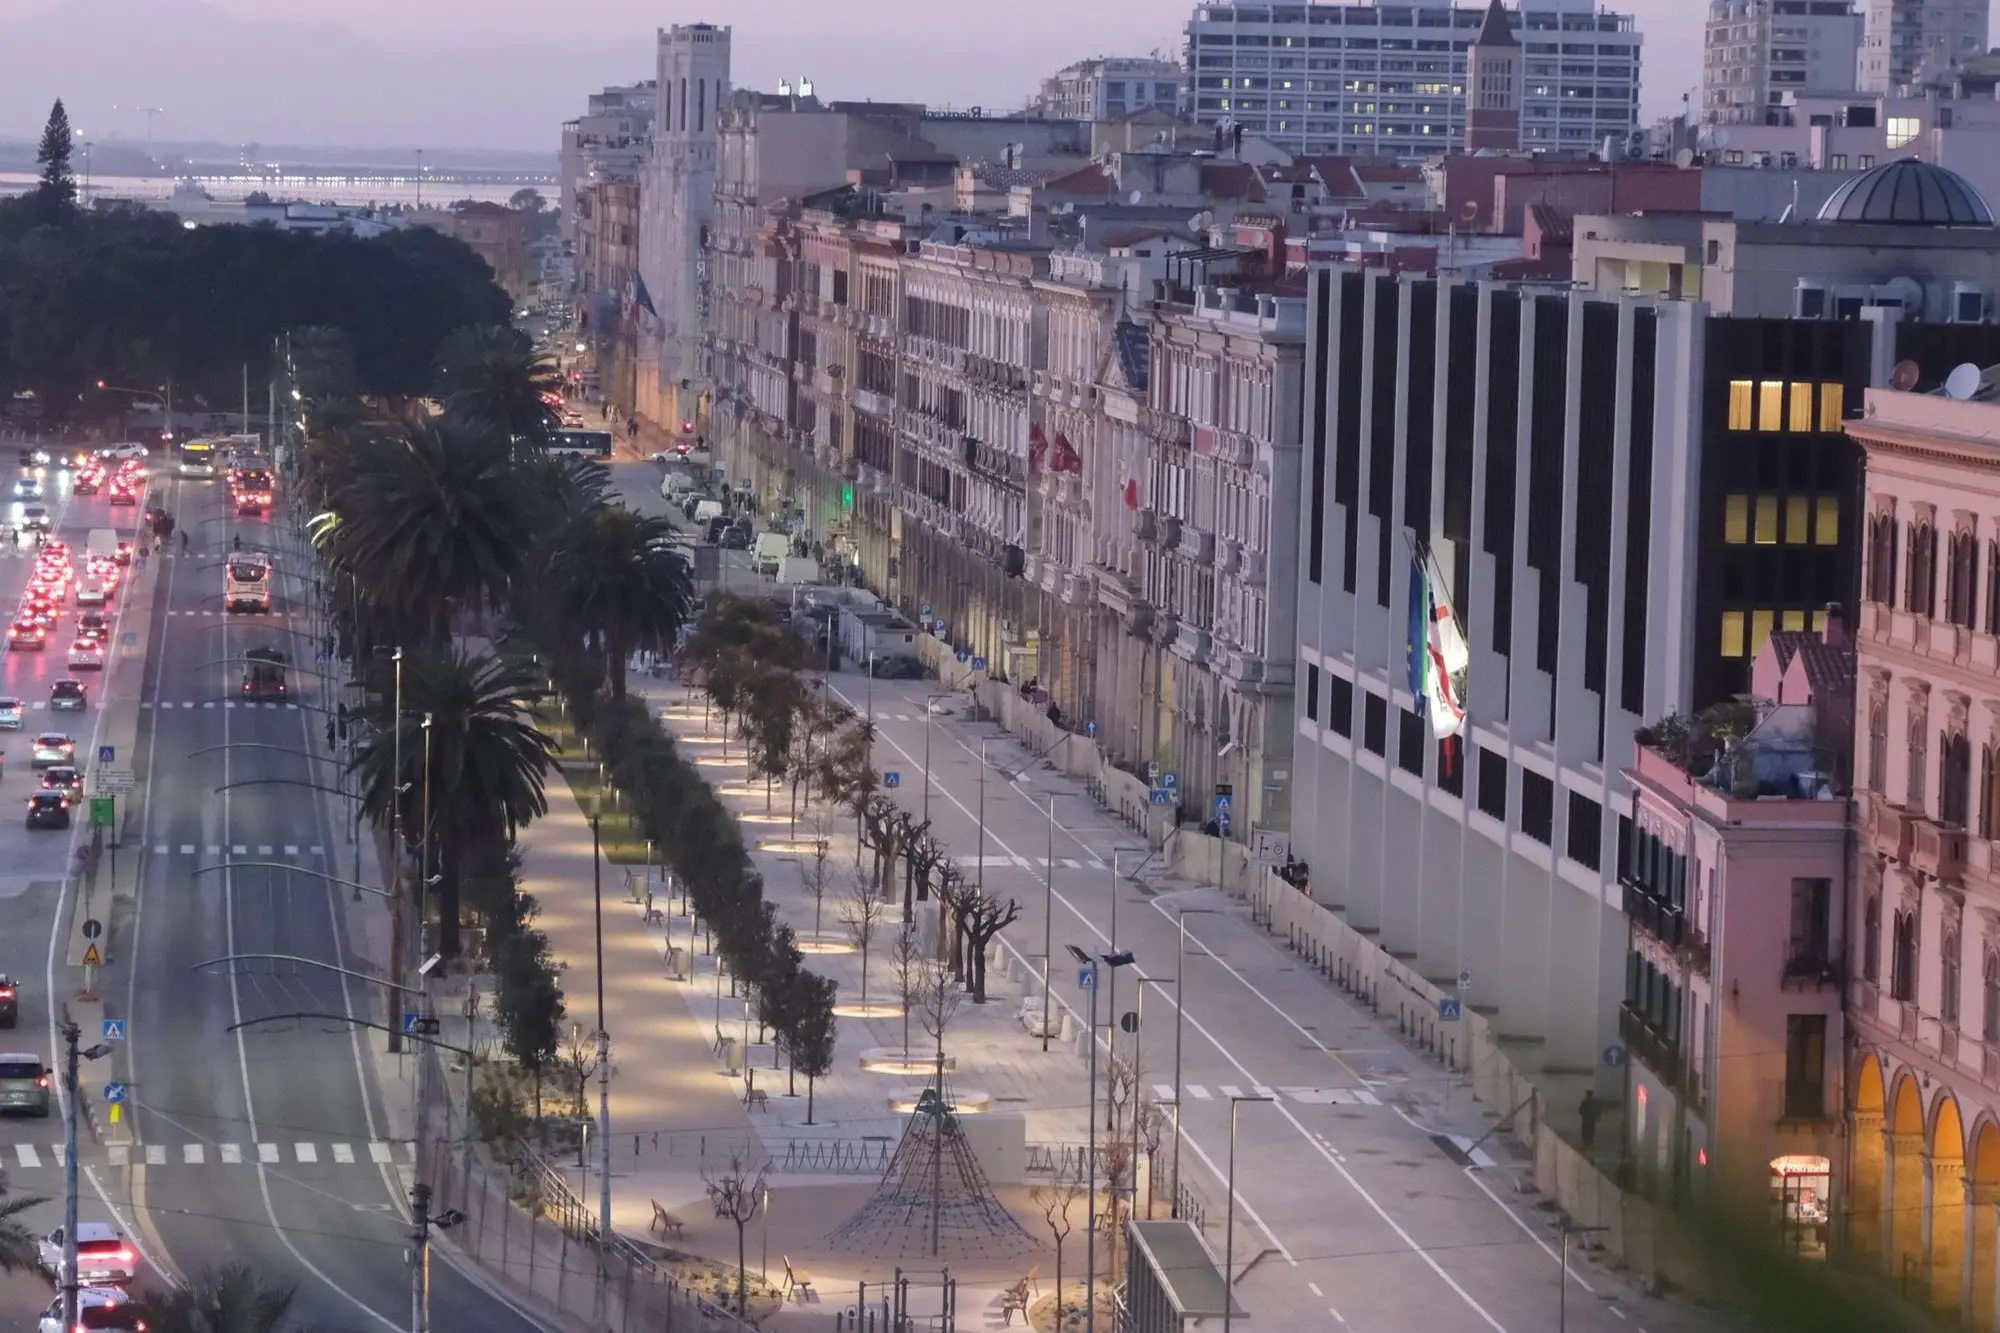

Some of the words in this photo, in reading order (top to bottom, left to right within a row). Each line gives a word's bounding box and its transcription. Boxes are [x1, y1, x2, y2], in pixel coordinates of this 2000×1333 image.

[922, 604, 930, 614] P
[936, 620, 944, 629] P
[1165, 774, 1174, 787] P
